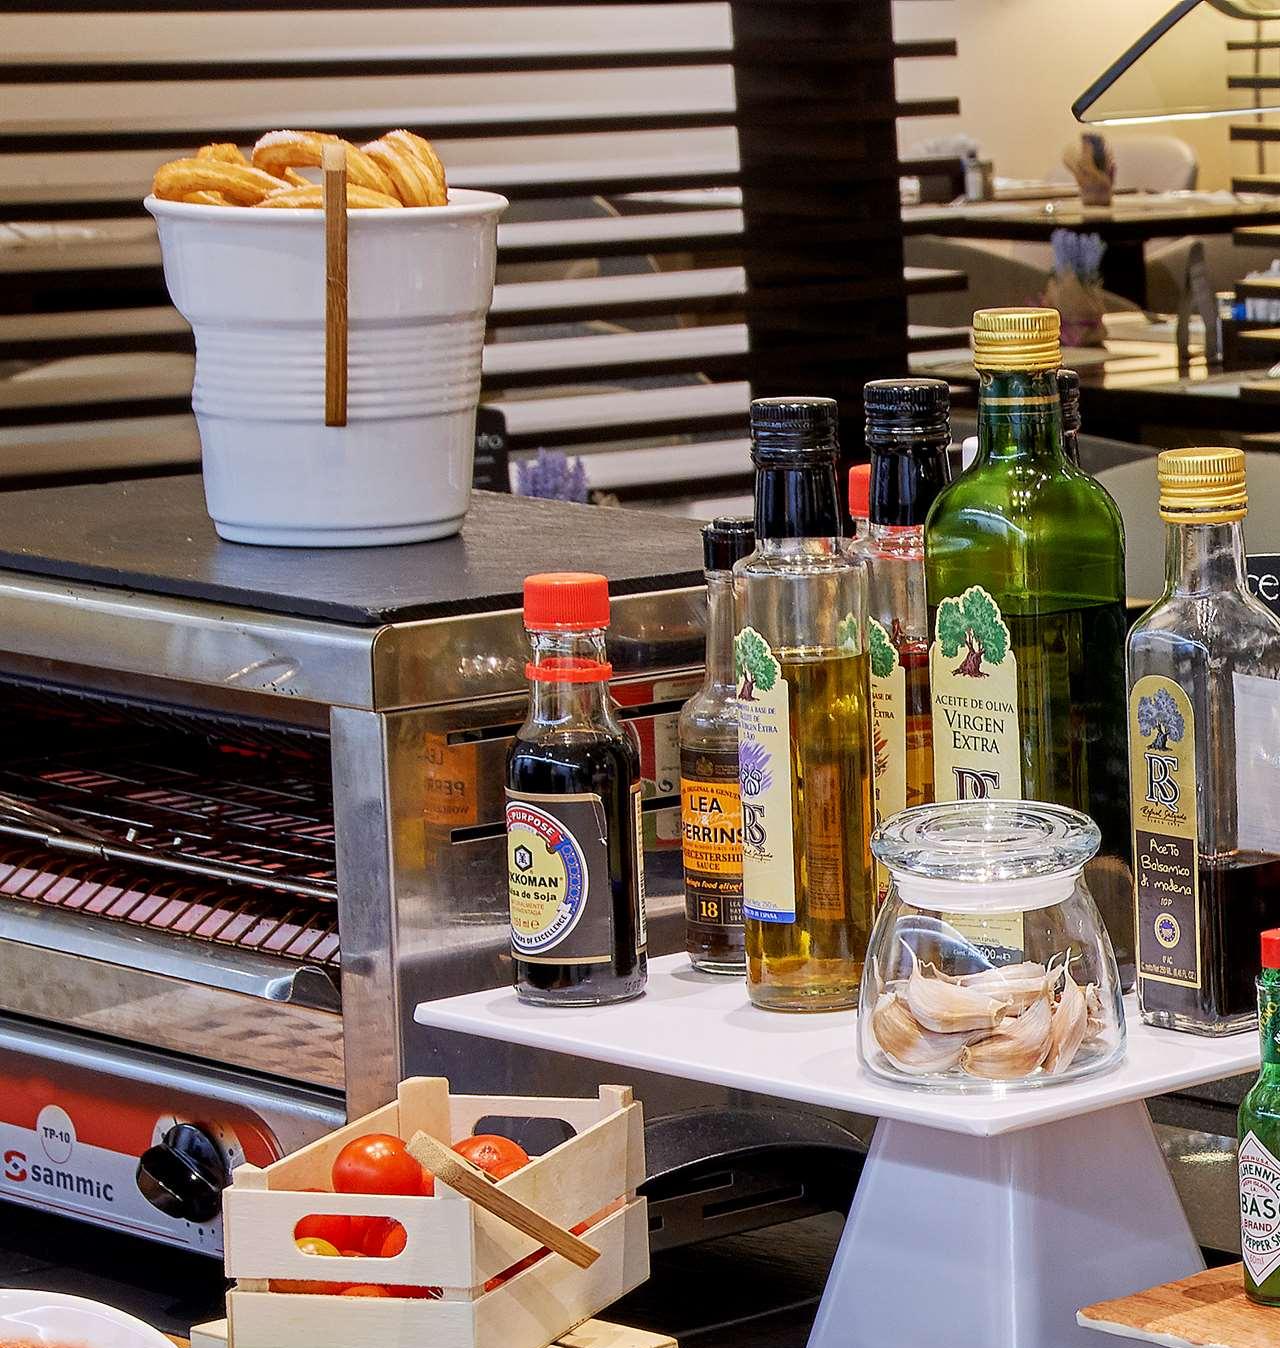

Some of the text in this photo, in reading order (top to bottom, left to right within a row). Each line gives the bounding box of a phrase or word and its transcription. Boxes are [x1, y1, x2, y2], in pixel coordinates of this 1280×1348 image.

[935, 695, 1014, 713] ACEITE DE OLIVA
[944, 709, 1004, 734] VIRGEN
[952, 731, 999, 753] EXTRA
[1144, 753, 1179, 813] RS
[690, 795, 722, 814] LEA
[697, 861, 720, 872] SAUCE
[1141, 855, 1190, 877] Balsamico
[702, 880, 717, 890] food
[522, 891, 557, 903] de Soja
[701, 901, 718, 918] 18
[527, 936, 534, 945] OF
[534, 914, 568, 943] EXCELLENCE
[42, 1126, 71, 1144] TP-10
[31, 1164, 114, 1202] sammic
[1246, 1234, 1272, 1252] PEPPER
